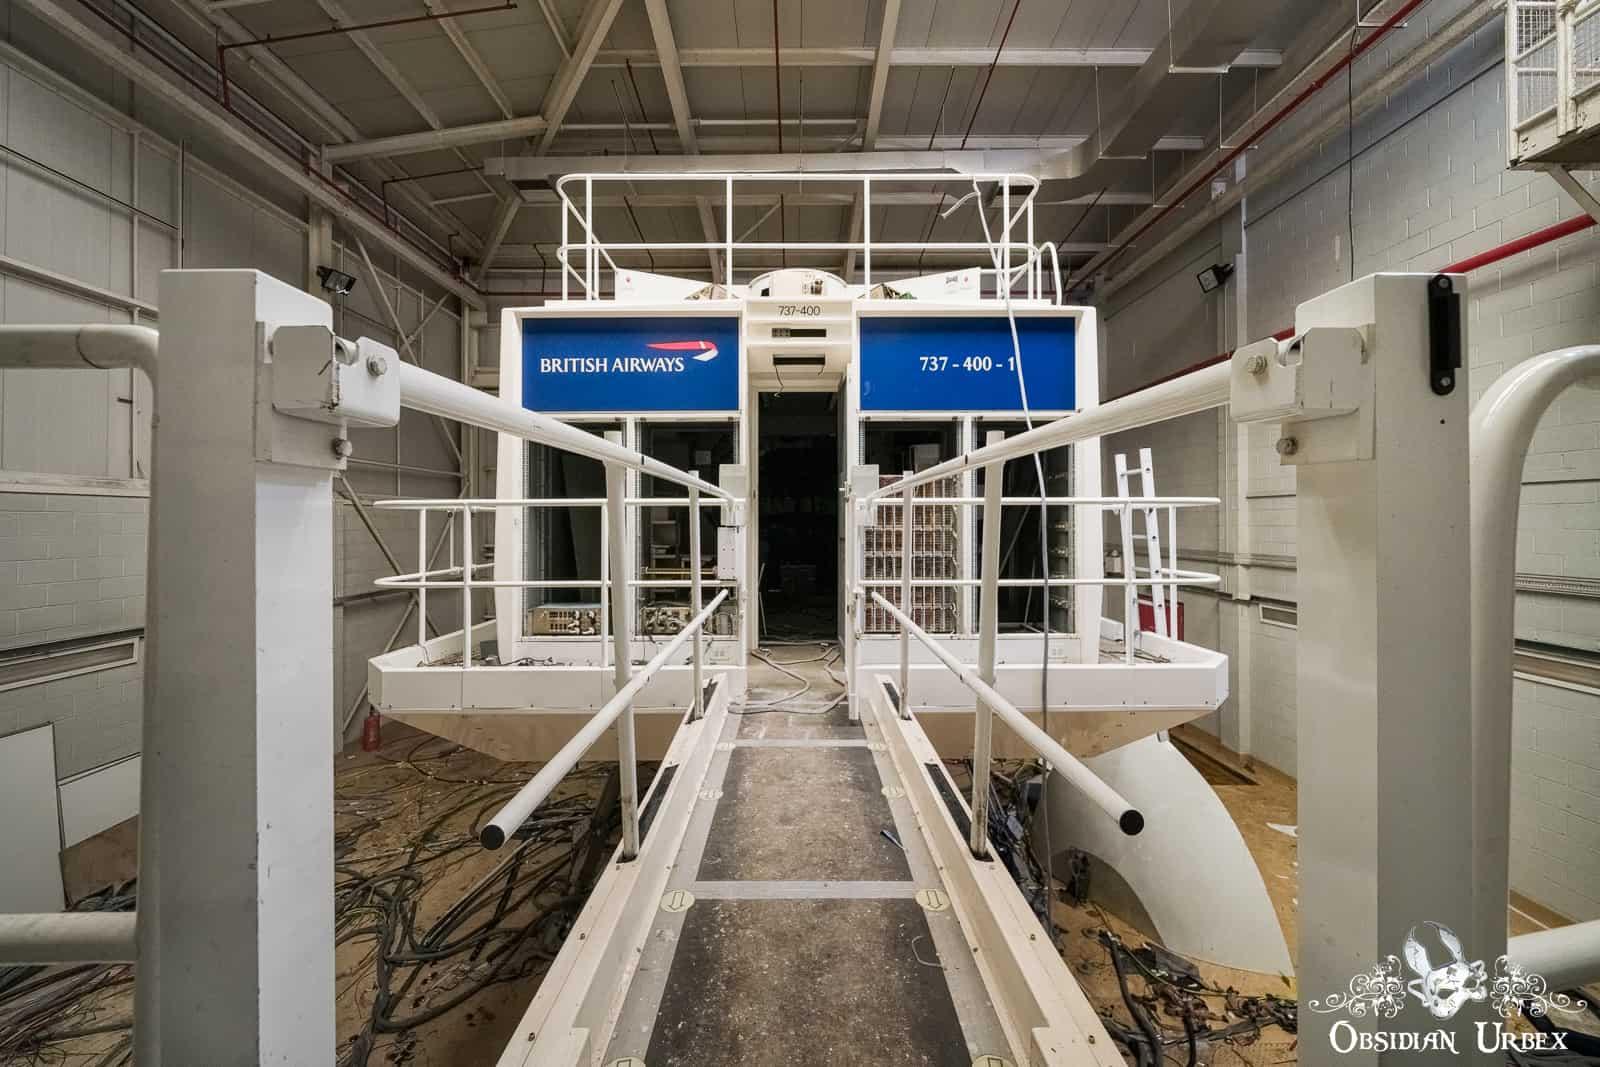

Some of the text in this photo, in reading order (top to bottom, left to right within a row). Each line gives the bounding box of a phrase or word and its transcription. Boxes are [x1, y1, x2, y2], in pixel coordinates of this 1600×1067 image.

[778, 304, 821, 317] 737-400
[540, 357, 684, 373] BRITISH AIRWAYS
[919, 356, 948, 371] 737
[963, 356, 992, 371] 400
[1007, 356, 1015, 371] 1
